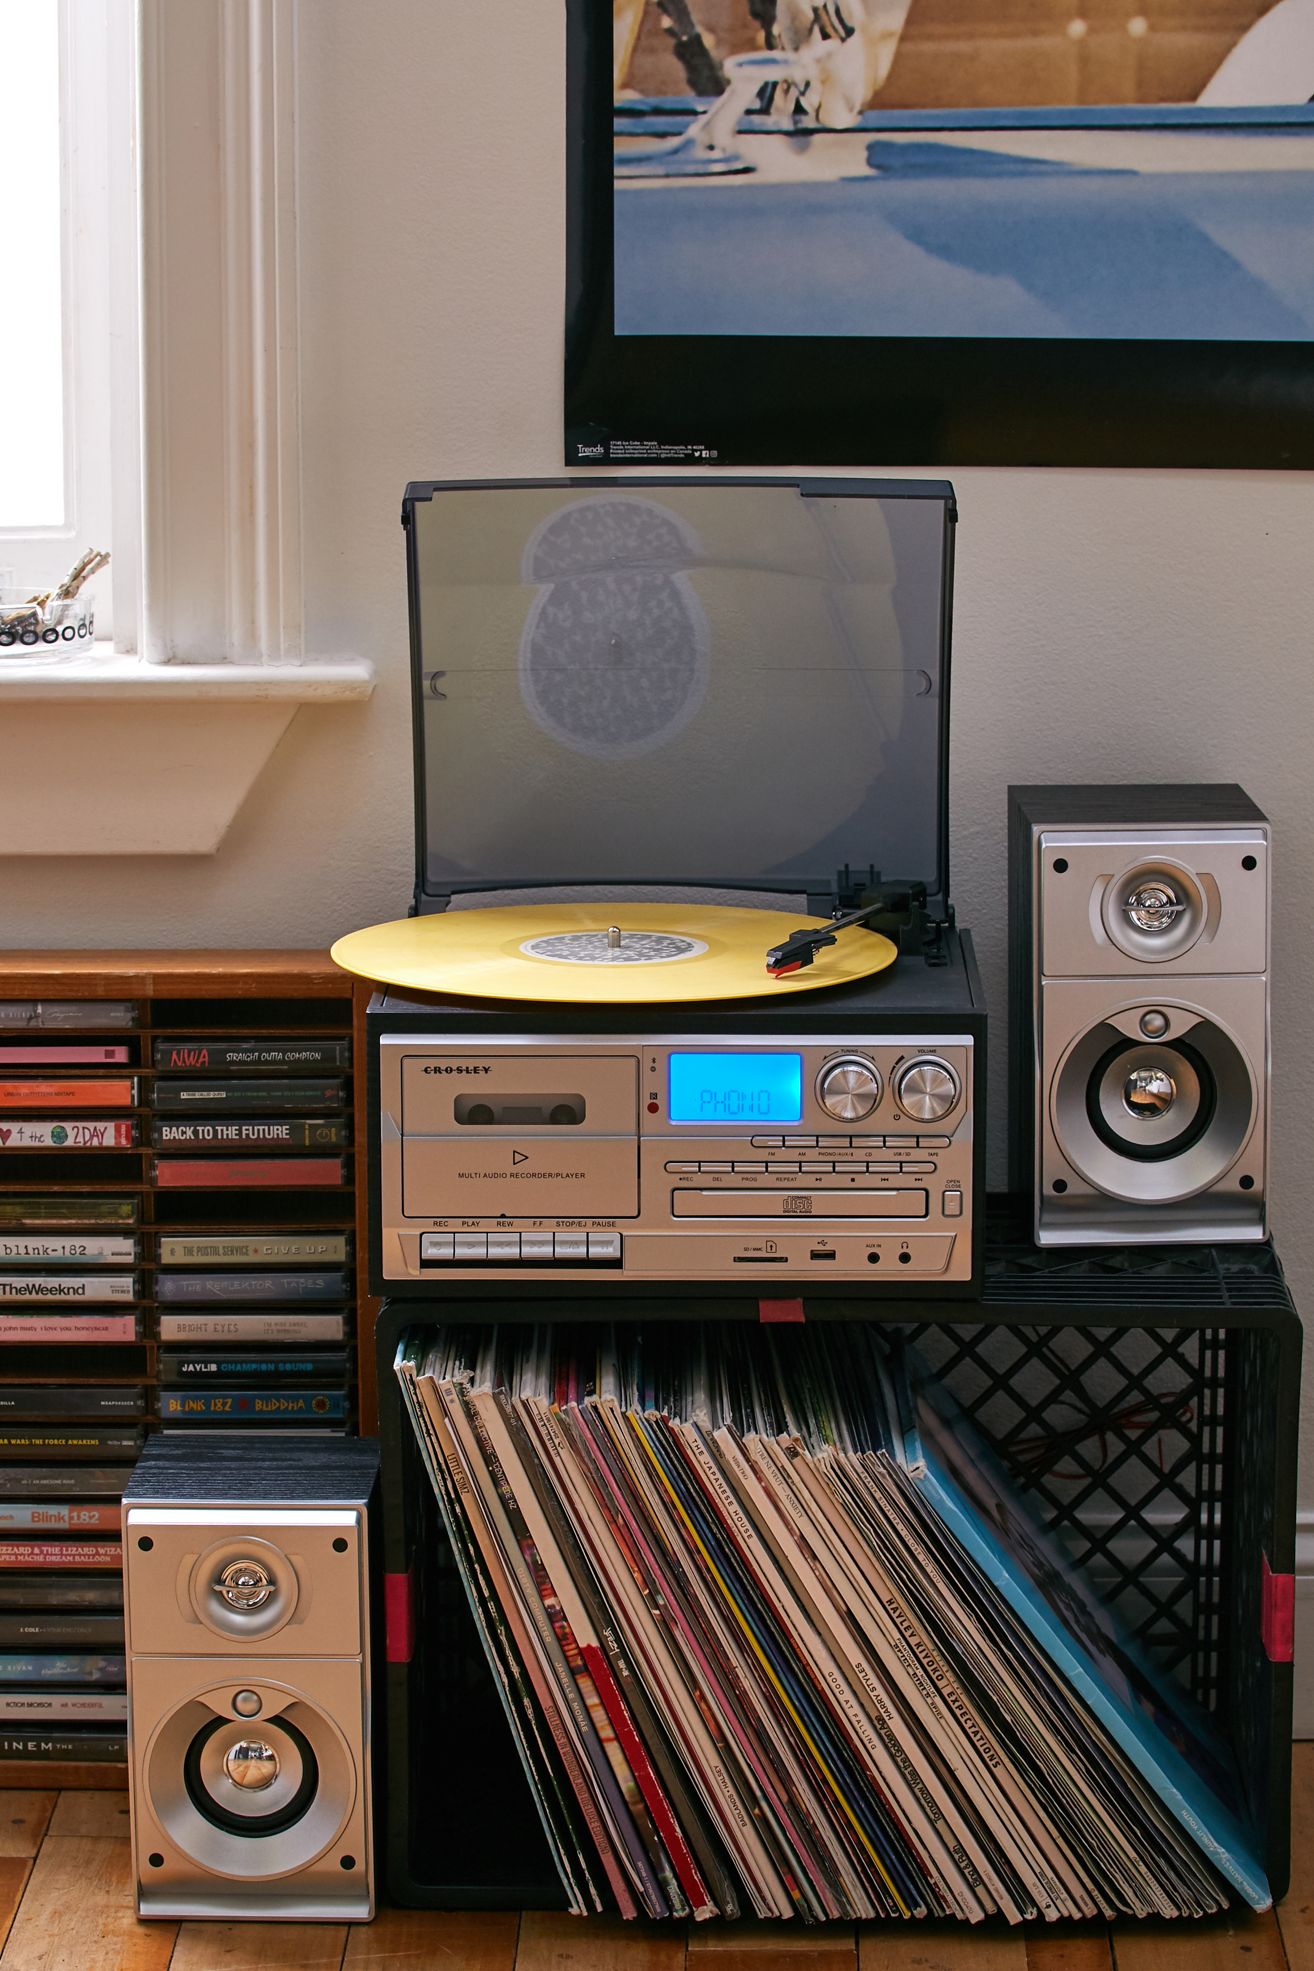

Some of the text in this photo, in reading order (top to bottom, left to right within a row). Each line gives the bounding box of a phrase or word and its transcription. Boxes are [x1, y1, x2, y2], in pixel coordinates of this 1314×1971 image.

[577, 444, 604, 453] Trends
[226, 1052, 321, 1062] STRAIGHT OUTTA COMPTON
[422, 1066, 492, 1074] CROSLEY
[701, 1090, 770, 1115] PHONO
[29, 1131, 45, 1144] the
[72, 1125, 108, 1146] 2DAY
[162, 1127, 194, 1140] BACK
[197, 1127, 213, 1140] TO
[216, 1127, 239, 1140] THE
[242, 1126, 290, 1139] FUTURE
[783, 1197, 812, 1210] disc
[3, 1245, 87, 1256] blink-182
[184, 1247, 196, 1257] THE
[197, 1247, 222, 1257] POSTAL
[223, 1246, 249, 1257] SERVICE
[264, 1247, 300, 1255] GIVE
[307, 1246, 328, 1255] UP
[177, 1323, 240, 1333] BRIGHT EYES
[182, 1363, 313, 1372] JAYLIB CHAMPION SOUND
[169, 1399, 305, 1412] BLINK 182 BUDDHA
[447, 1453, 470, 1495] LITTLE SIMZ
[692, 1439, 705, 1457] THE
[704, 1461, 734, 1508] JAPANESE
[733, 1510, 753, 1540] HOUSE
[508, 1499, 517, 1510] HZ
[785, 1494, 803, 1519] ANXIETY
[32, 1511, 99, 1524] Blink 182
[861, 1471, 878, 1494] FRANK
[880, 1497, 900, 1527] SINATRA
[904, 1534, 922, 1556] CLOSE
[921, 1558, 929, 1568] TO
[530, 1597, 551, 1643] COMPUTER
[897, 1638, 920, 1672] PHANTOGRAM
[555, 1663, 575, 1700] JANELLE
[855, 1662, 894, 1721] HARRY STYLES
[886, 1598, 1001, 1770] HAYLEY KIYOKO EXPECTATIONS
[828, 1671, 877, 1750] GOOD AT FALLING
[5, 1742, 53, 1751] INEM
[545, 1705, 564, 1742] STILLNESS
[562, 1748, 588, 1797] WONDERLAND
[875, 1715, 943, 1824] Tomorrow Was the Golden Age
[714, 1766, 748, 1828] BADLANDS HALSEY
[1182, 1809, 1198, 1830] YOUTH
[952, 1845, 967, 1863] Ruth
[968, 1869, 982, 1888] Bing
